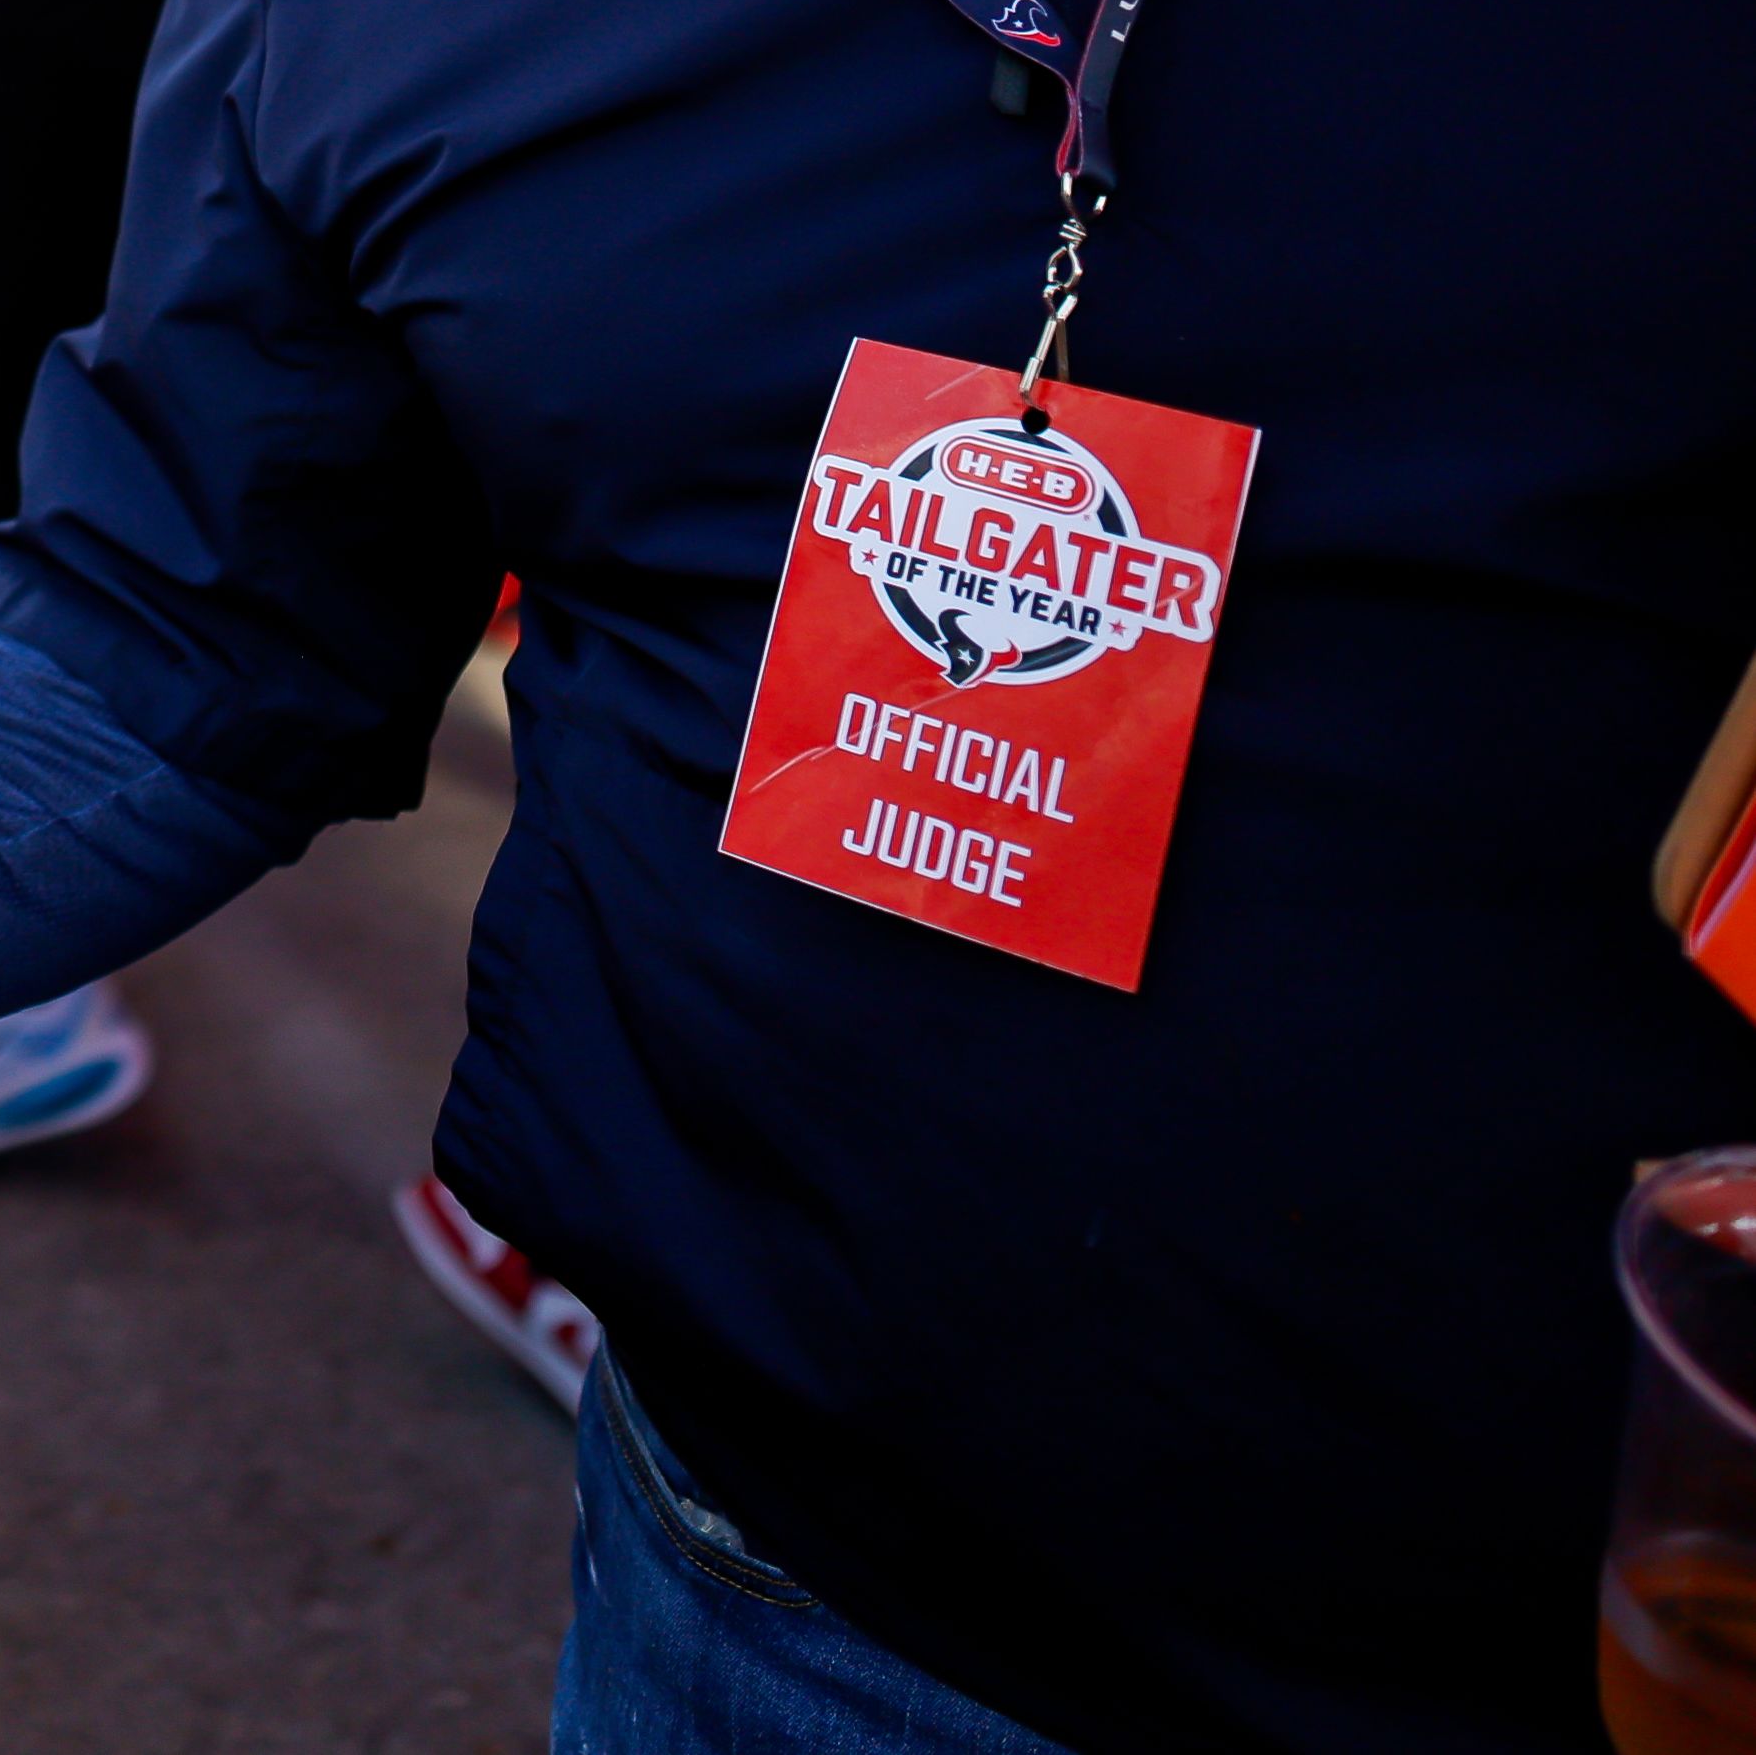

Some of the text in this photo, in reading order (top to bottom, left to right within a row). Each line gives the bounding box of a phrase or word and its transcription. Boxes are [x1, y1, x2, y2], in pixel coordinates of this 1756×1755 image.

[824, 464, 1206, 631] TAILGATER
[886, 551, 1104, 637] OF THE YEAR
[835, 691, 1075, 824] OFFICIAL
[841, 797, 1033, 908] JUDGE
